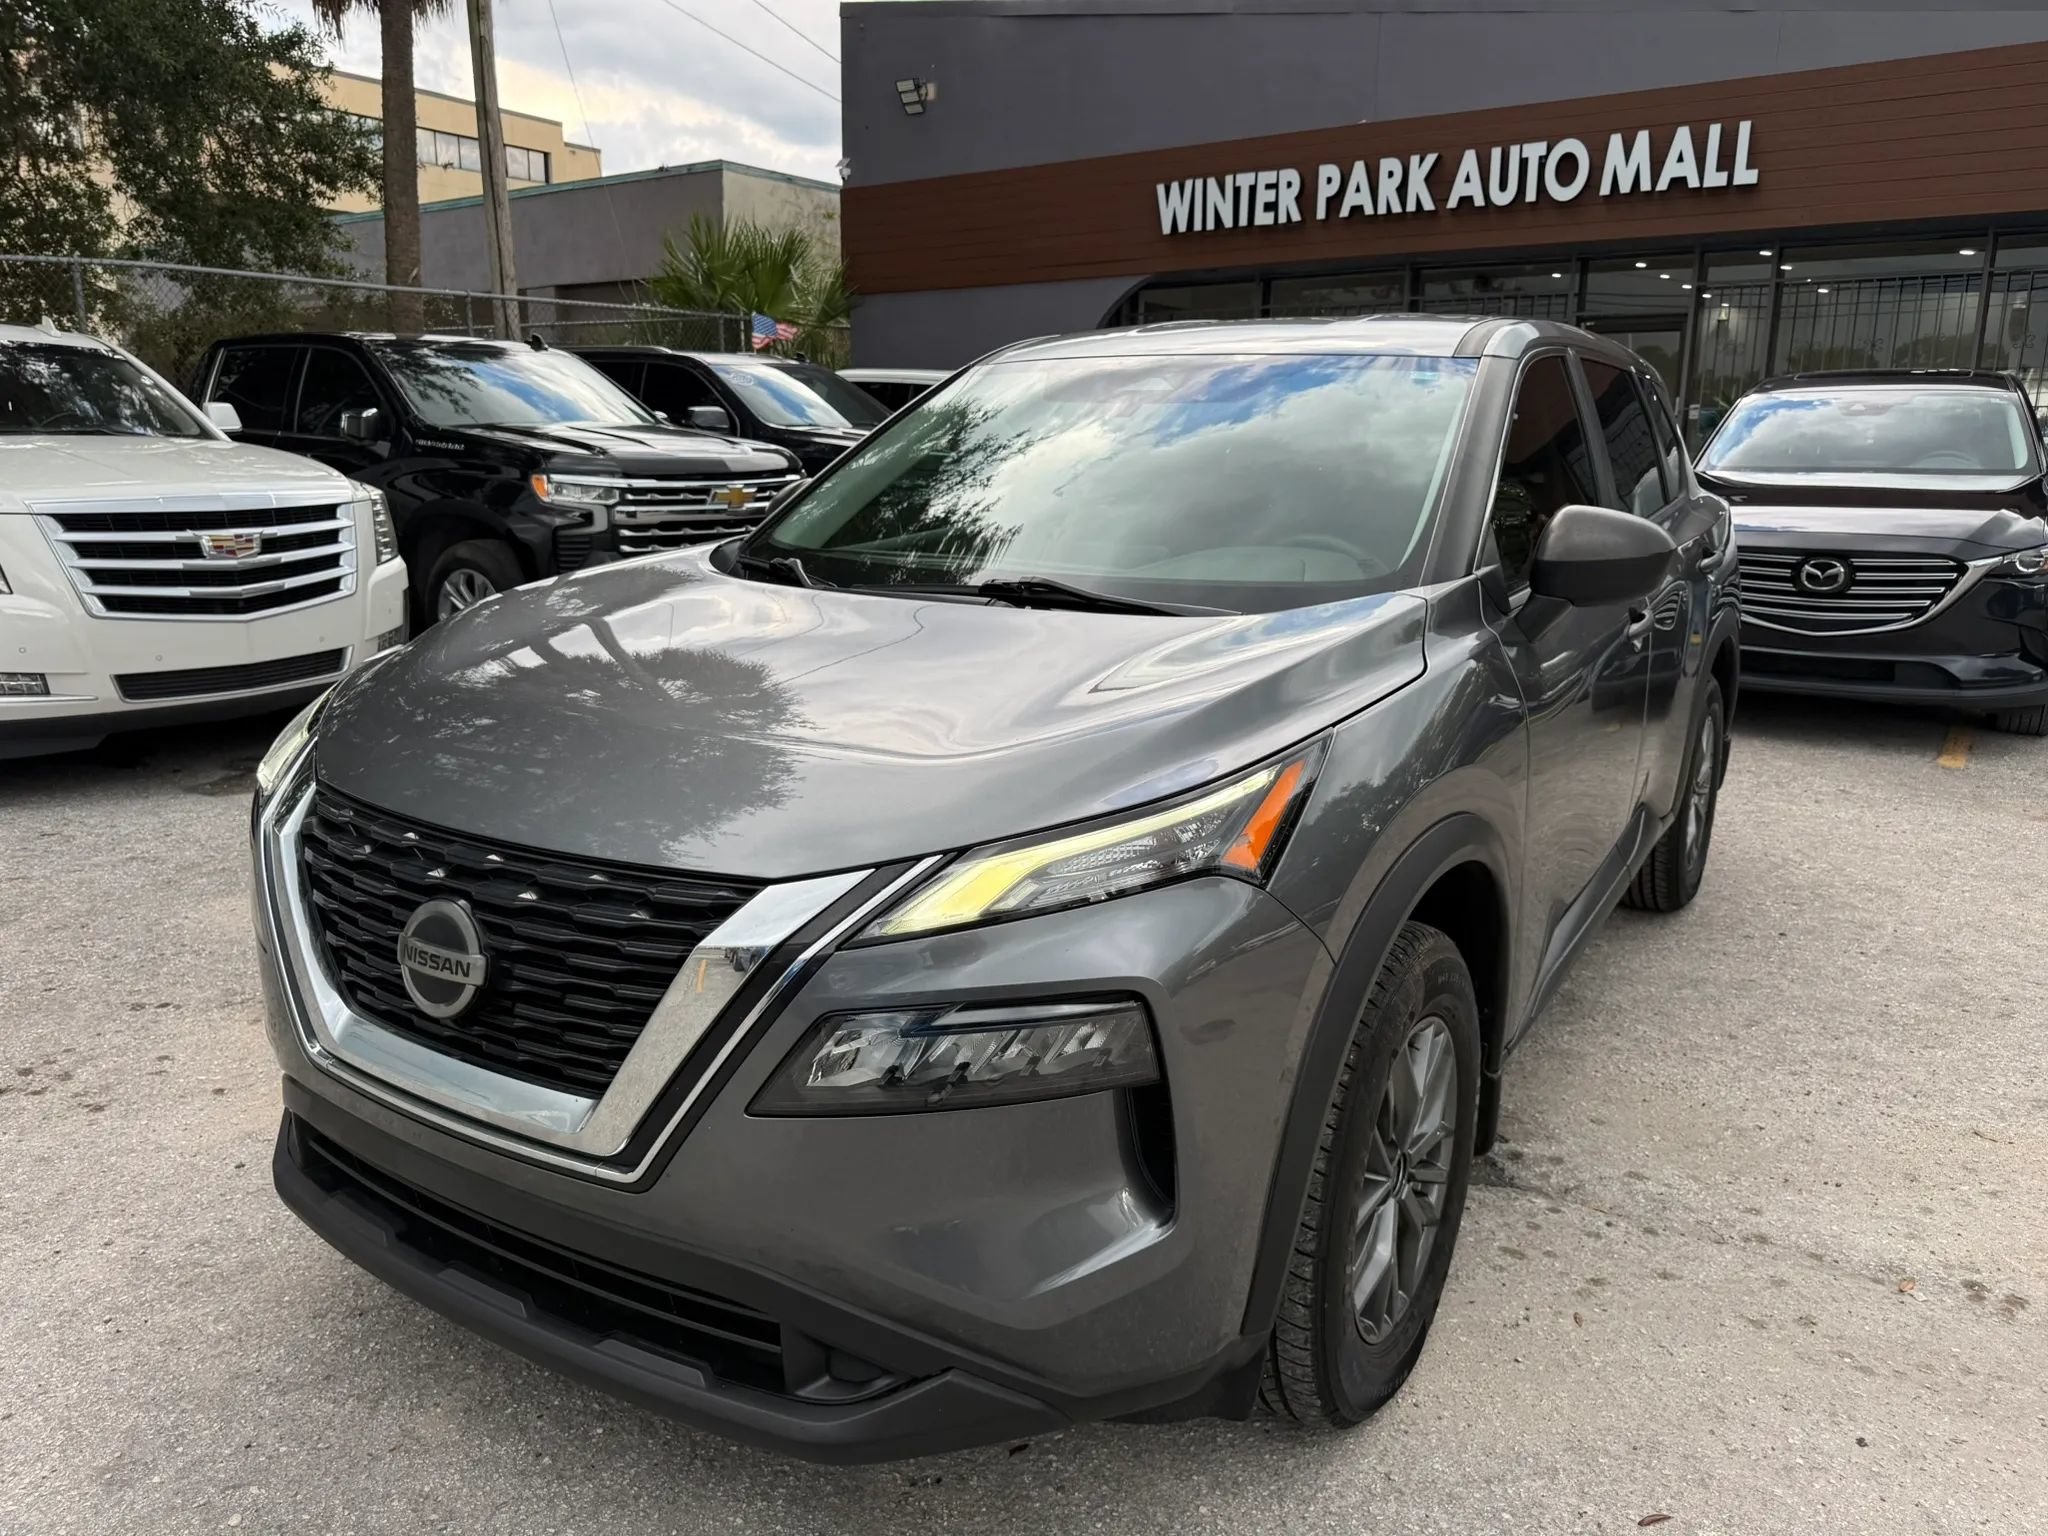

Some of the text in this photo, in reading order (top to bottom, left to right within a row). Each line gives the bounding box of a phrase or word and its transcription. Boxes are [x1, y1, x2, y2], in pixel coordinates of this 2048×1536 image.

[1156, 120, 1759, 235] WINTER PARK AUTO MALL
[402, 943, 471, 978] NISSAN
